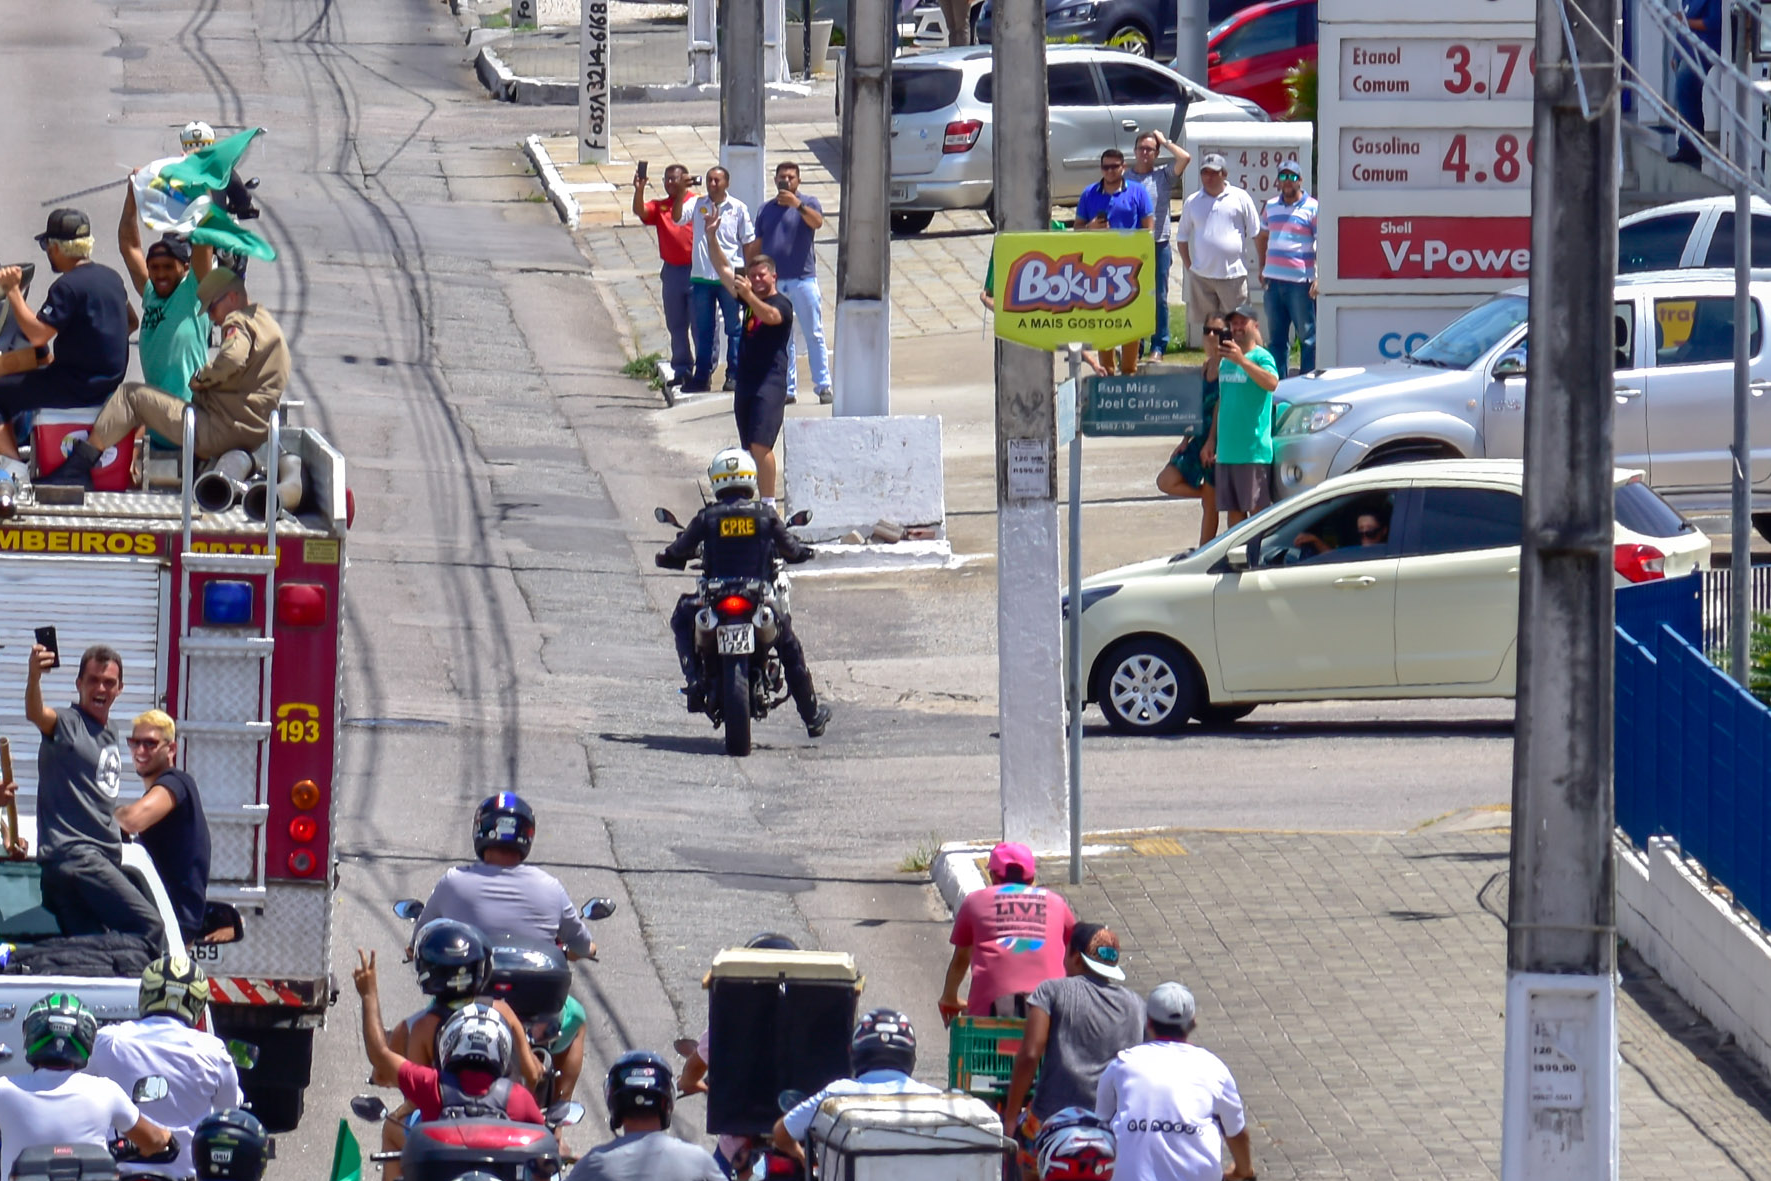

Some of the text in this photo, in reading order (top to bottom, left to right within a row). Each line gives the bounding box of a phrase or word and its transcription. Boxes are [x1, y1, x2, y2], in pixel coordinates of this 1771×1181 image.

[1352, 47, 1401, 65] Etanol
[1444, 44, 1536, 94] 3.7
[1352, 75, 1410, 93] Comum
[1352, 136, 1420, 155] Gasolina
[1442, 134, 1534, 183] 4.8
[1352, 164, 1409, 182] Comum
[1380, 221, 1412, 234] Shell
[1018, 318, 1133, 329] A MAIS GOSTOSA
[1097, 383, 1122, 393] Rua
[1097, 398, 1179, 409] Joel Carlson
[721, 519, 756, 536] CPRE
[277, 720, 320, 743] 193
[995, 902, 1047, 916] LIVE
